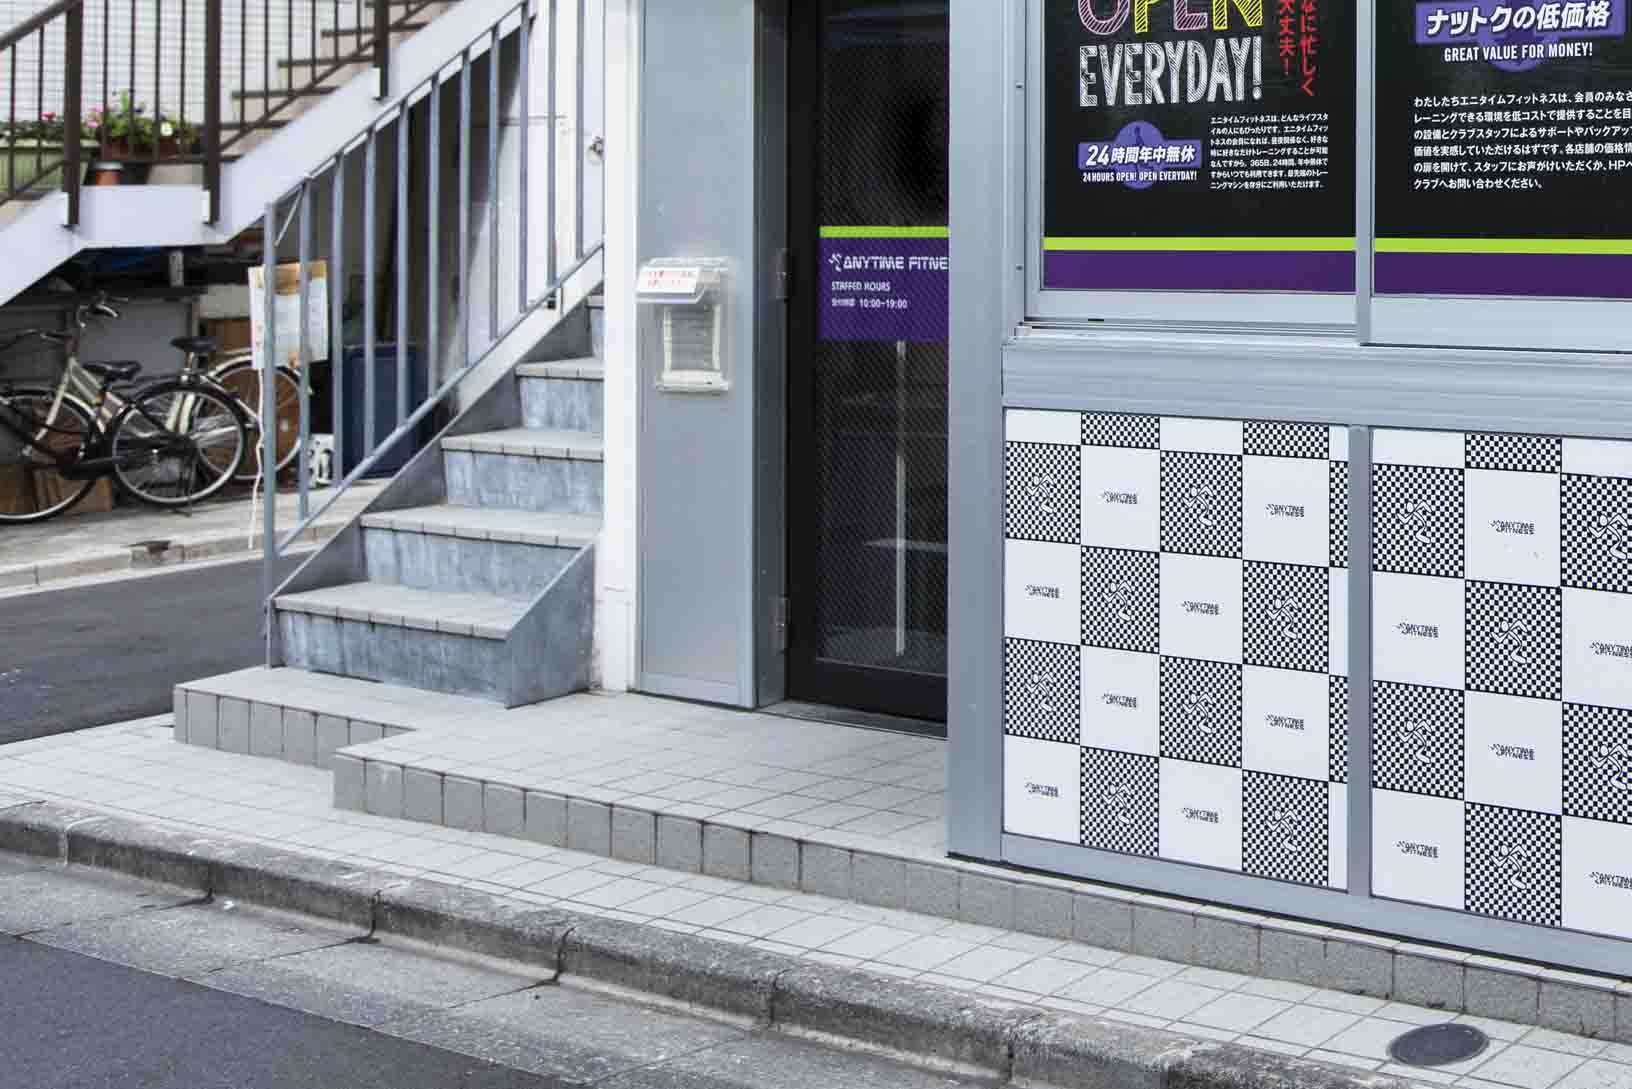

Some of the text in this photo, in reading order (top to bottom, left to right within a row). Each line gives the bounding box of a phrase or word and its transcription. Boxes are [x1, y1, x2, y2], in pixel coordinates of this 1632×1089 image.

[1426, 0, 1611, 35] ナットクの低価格
[1444, 42, 1593, 62] GREAT VALUE FOR MONEY!
[1079, 36, 1263, 107] EVERYDAY!
[1086, 145, 1195, 166] 24時間年中無休
[1139, 171, 1158, 182] OPEN
[843, 256, 949, 270] ANYTIME FITNE
